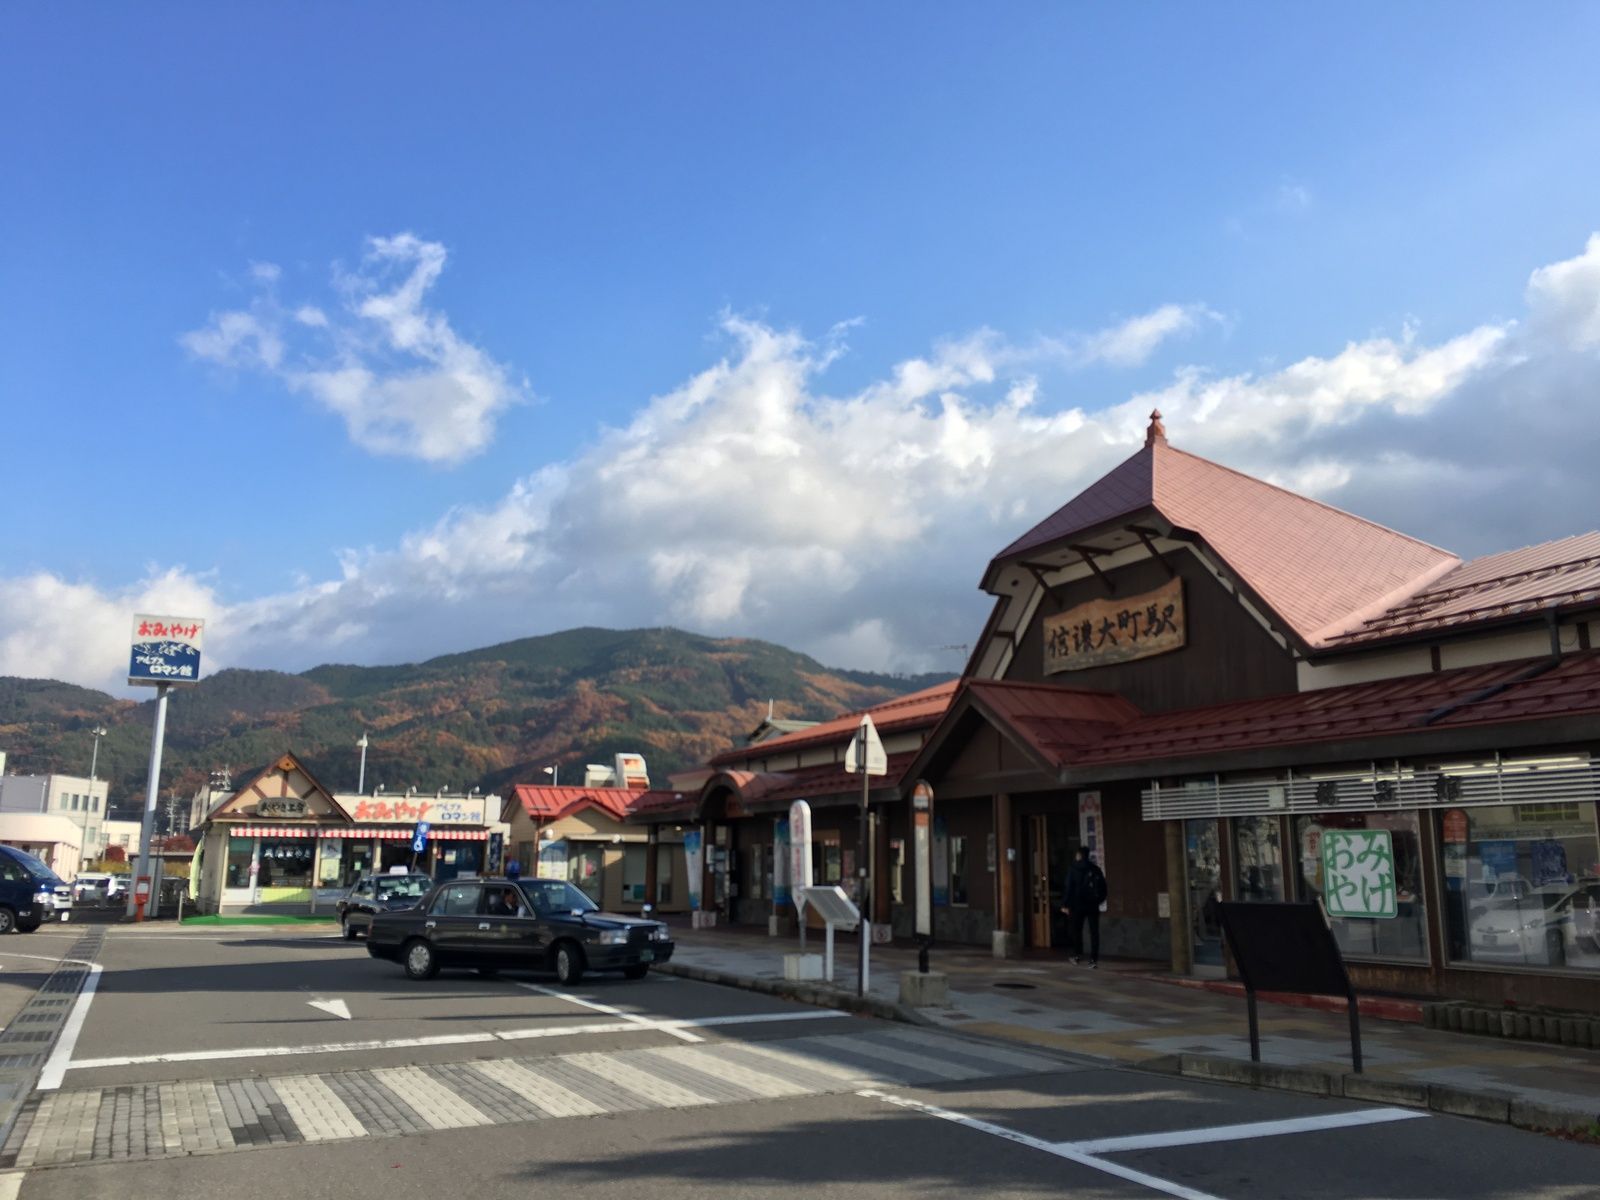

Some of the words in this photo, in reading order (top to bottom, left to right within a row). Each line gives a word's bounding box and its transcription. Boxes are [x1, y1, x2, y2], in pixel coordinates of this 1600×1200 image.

[138, 621, 202, 639] おみやげ
[136, 656, 164, 666] アルプス
[354, 800, 433, 820] おみやげ
